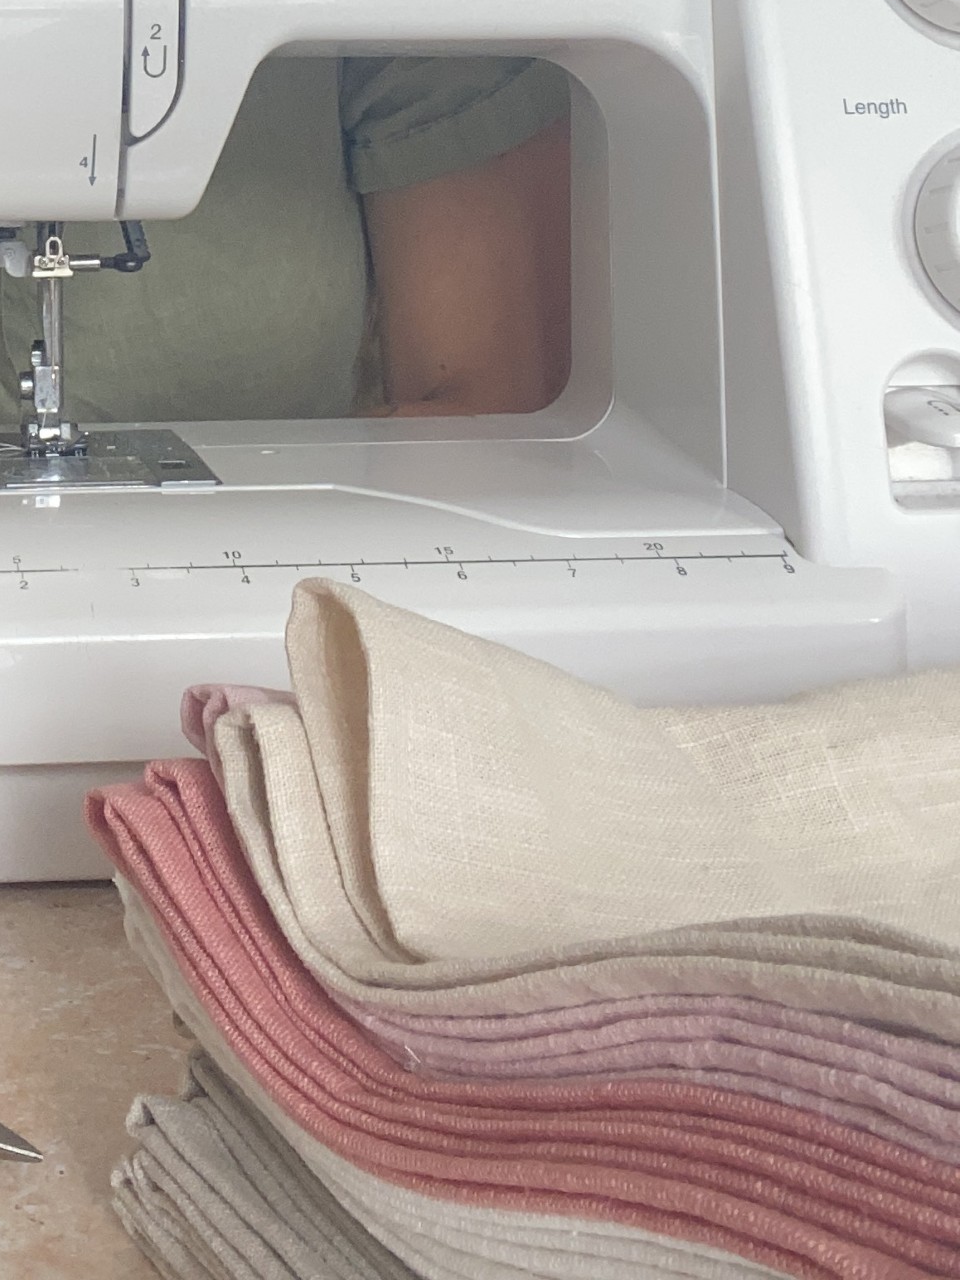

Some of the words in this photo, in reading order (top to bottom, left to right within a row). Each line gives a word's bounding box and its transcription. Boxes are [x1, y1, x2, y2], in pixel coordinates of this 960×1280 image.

[149, 23, 162, 40] 2
[842, 98, 908, 119] Length
[78, 156, 89, 168] 4
[12, 555, 22, 564] 5
[222, 551, 242, 560] 10
[434, 546, 454, 555] 15
[643, 542, 664, 551] 20
[19, 580, 29, 590] 2
[131, 577, 141, 588] 3
[241, 575, 251, 585] 4
[351, 572, 361, 583] 5
[457, 570, 468, 581] 6
[567, 568, 577, 578] 7
[676, 566, 688, 576] 8
[783, 564, 796, 574] 9
